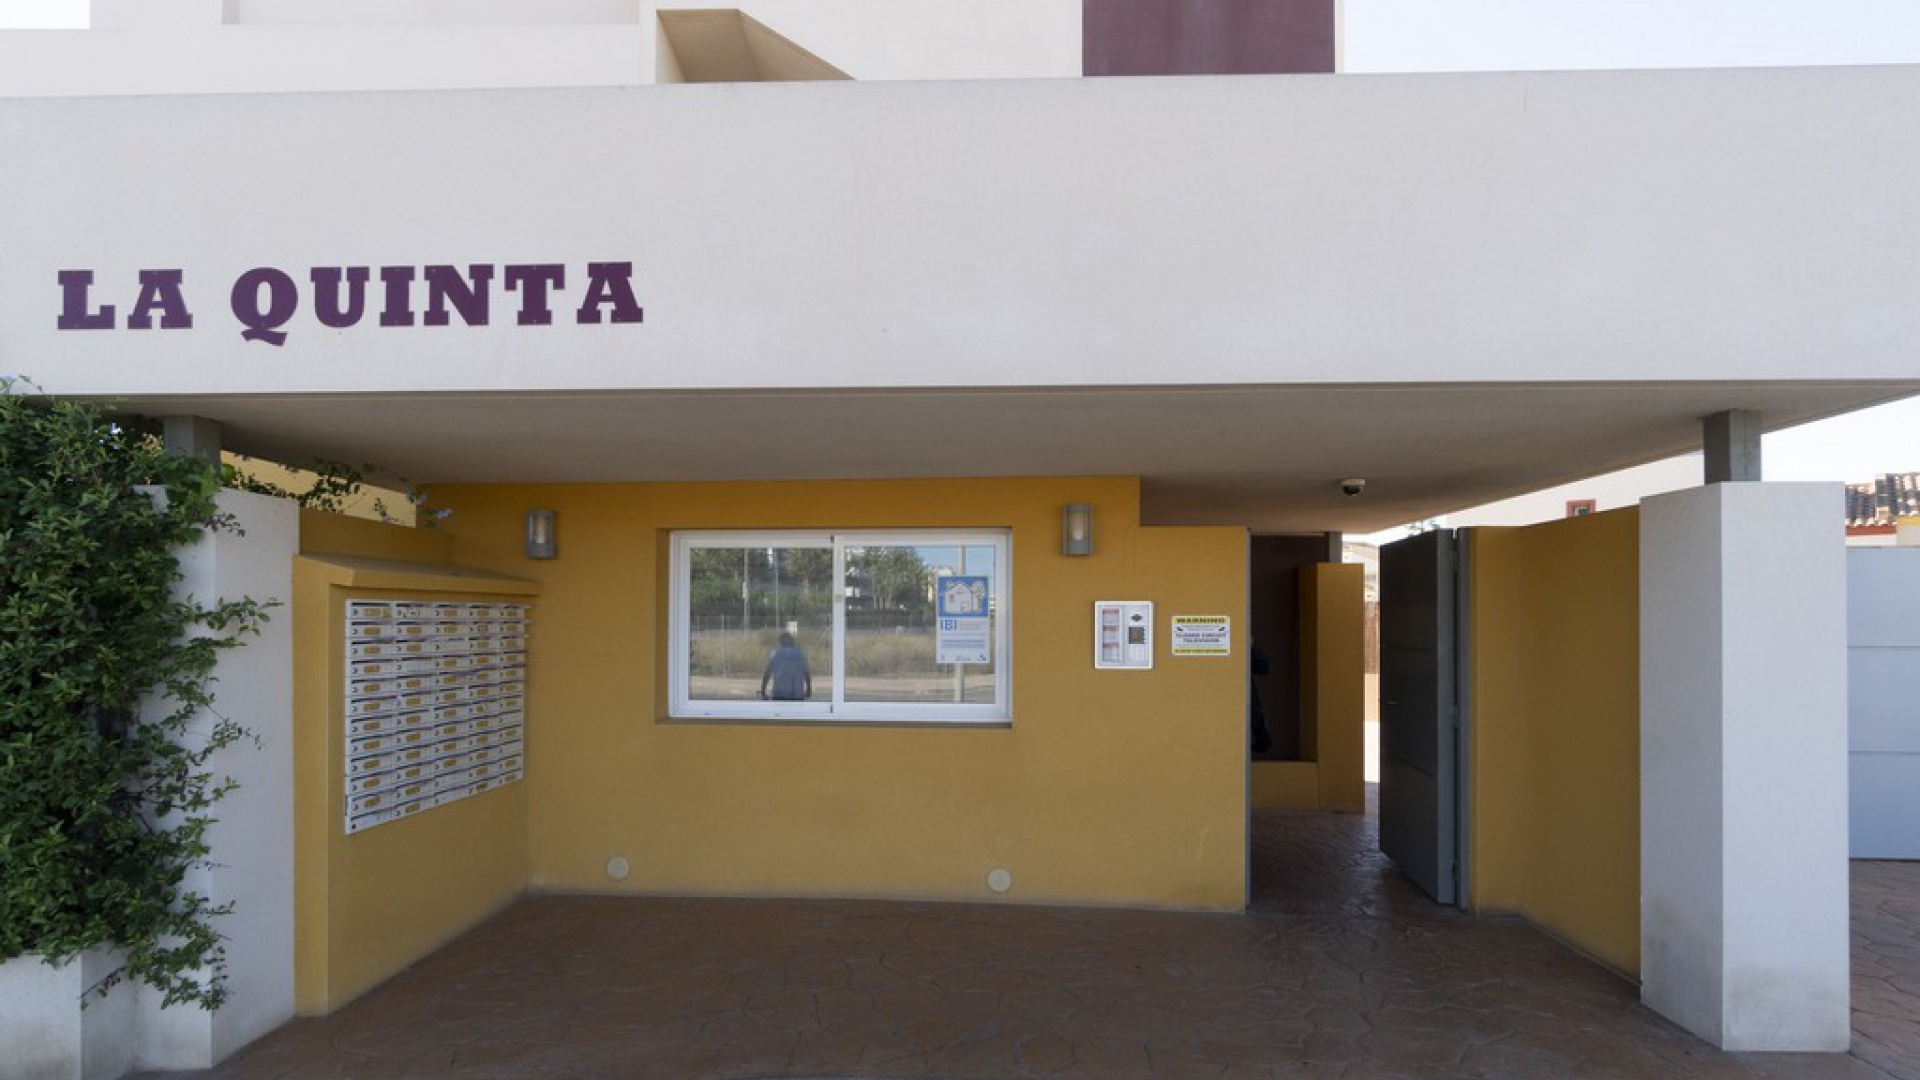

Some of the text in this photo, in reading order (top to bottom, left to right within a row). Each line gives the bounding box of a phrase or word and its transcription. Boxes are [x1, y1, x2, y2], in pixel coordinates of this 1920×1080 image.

[58, 261, 643, 346] LA QUINTA
[941, 619, 957, 631] IBI
